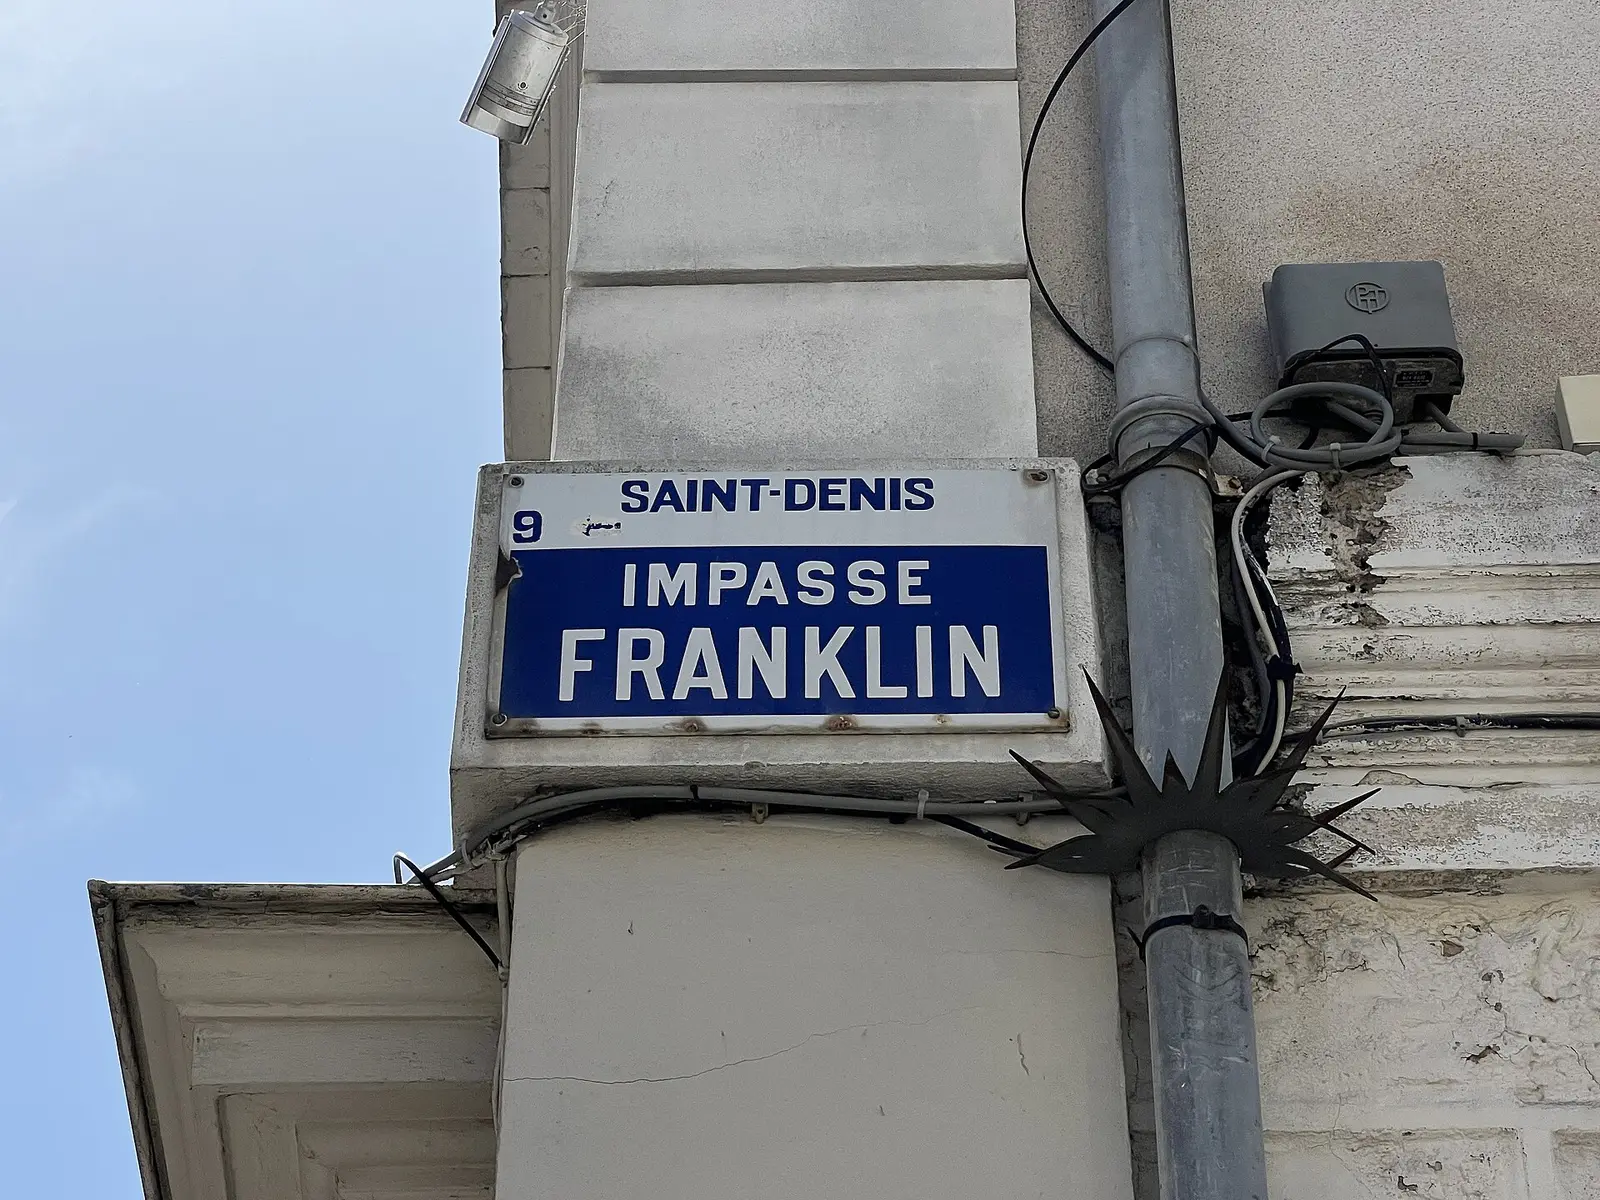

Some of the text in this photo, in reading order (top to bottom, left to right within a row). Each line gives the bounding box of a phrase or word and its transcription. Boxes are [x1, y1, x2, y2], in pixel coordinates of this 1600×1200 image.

[621, 477, 935, 513] SAINT-DENIS
[511, 511, 543, 543] 9
[623, 560, 932, 607] IMPASSE
[558, 625, 1001, 702] FRANKLIN
